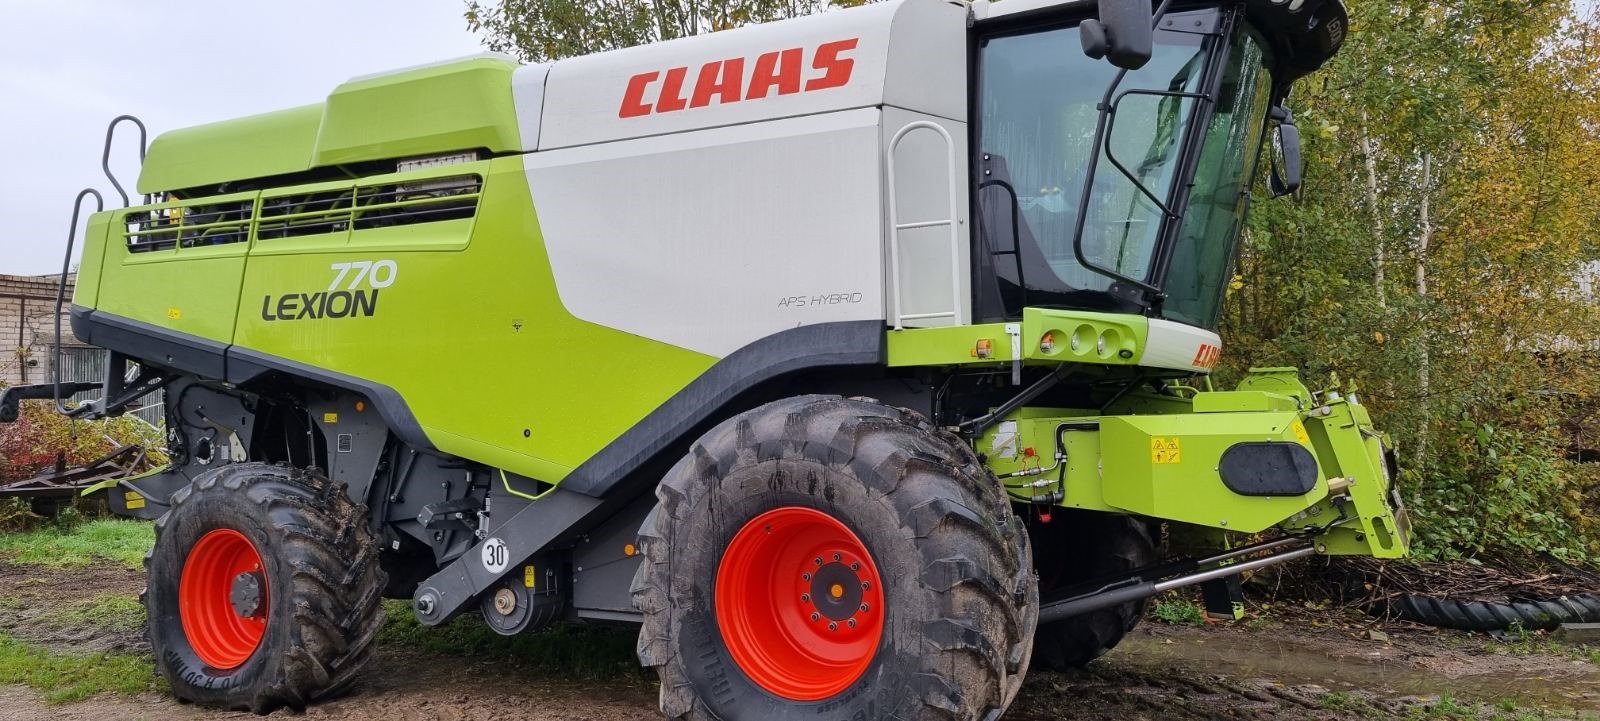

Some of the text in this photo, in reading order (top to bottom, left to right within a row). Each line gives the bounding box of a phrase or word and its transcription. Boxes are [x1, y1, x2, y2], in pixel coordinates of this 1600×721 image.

[619, 38, 859, 118] CLAAS
[328, 259, 398, 291] 770
[262, 289, 379, 321] LEXION
[778, 292, 863, 307] APS HYBRID
[487, 544, 504, 566] 30
